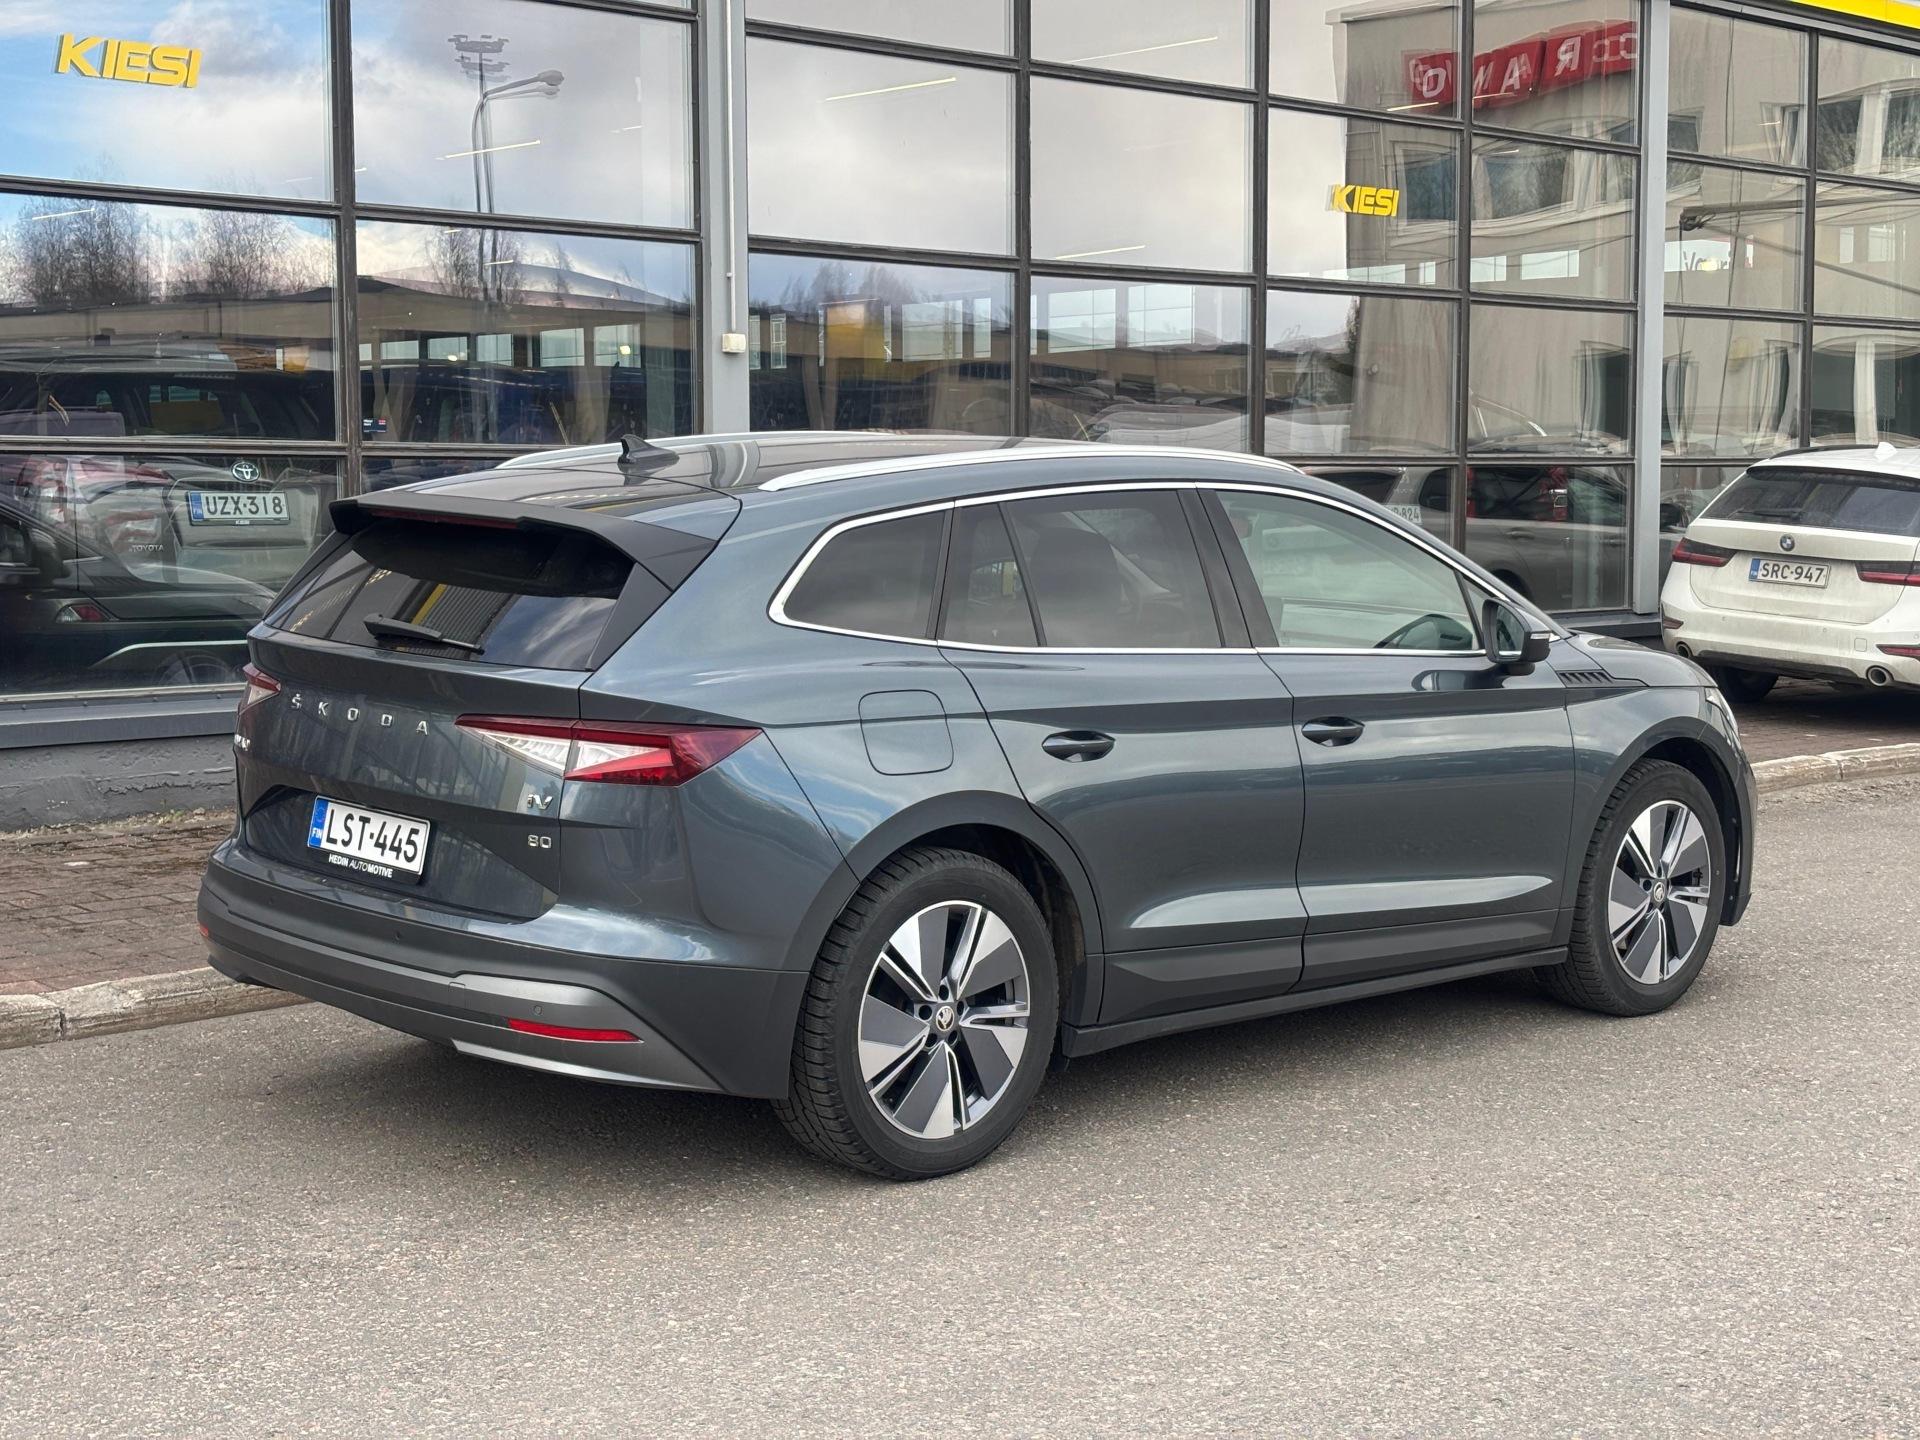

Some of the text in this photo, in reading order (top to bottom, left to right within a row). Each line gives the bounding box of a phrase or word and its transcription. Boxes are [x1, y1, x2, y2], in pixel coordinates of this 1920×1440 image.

[55, 32, 202, 89] KIESI
[1331, 184, 1399, 217] KIESI
[205, 496, 283, 515] UZX-318
[1761, 562, 1825, 583] SRC-947
[291, 693, 428, 735] ŠKODA
[326, 808, 420, 863] LST-445
[527, 834, 552, 848] 80
[328, 853, 393, 878] HEDIN AUTOMOTIVE
